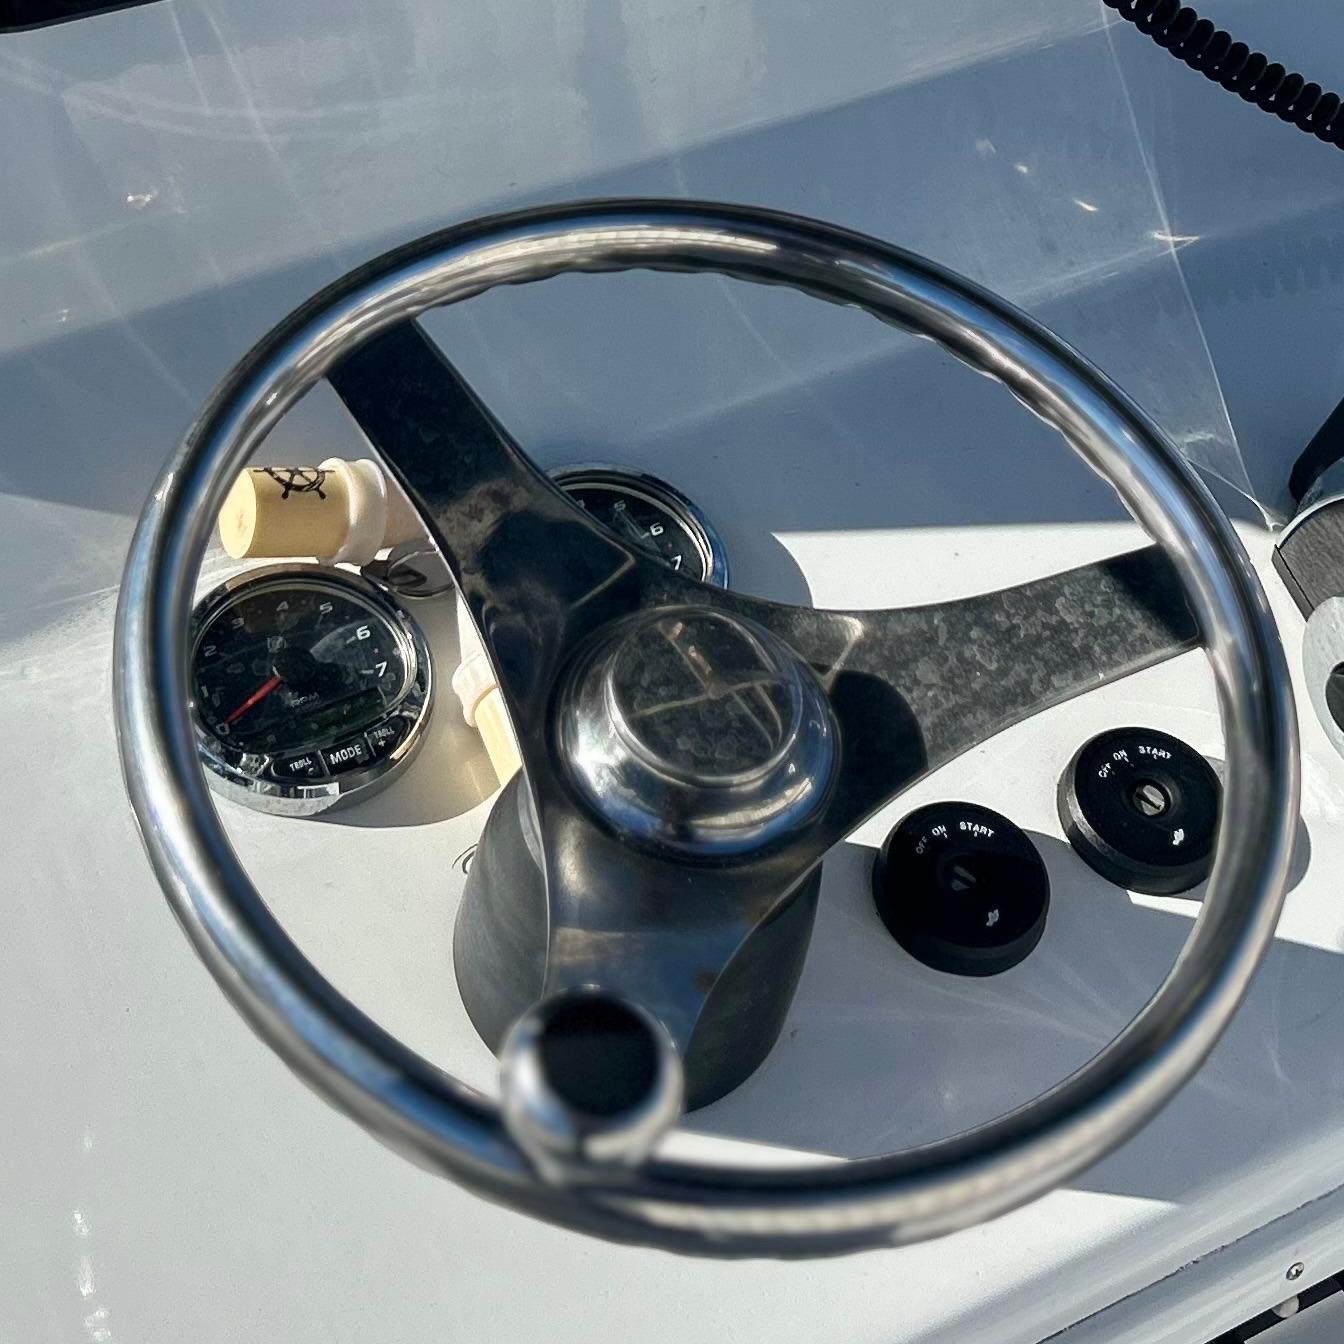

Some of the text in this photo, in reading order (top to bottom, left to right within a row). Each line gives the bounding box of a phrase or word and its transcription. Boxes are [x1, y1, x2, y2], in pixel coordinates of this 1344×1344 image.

[649, 522, 664, 536] 6
[671, 554, 682, 571] 7
[276, 601, 289, 611] 4
[319, 602, 333, 614] 5
[231, 617, 245, 629] 3
[356, 625, 371, 641] 6
[205, 645, 217, 656] 2
[375, 661, 388, 678] 7
[216, 722, 230, 736] 0
[373, 727, 396, 739] TROLL
[329, 744, 362, 765] MODE
[1113, 749, 1128, 760] ON
[1138, 745, 1172, 760] START
[289, 757, 312, 772] TROLL
[931, 824, 947, 836] ON
[959, 821, 995, 837] START
